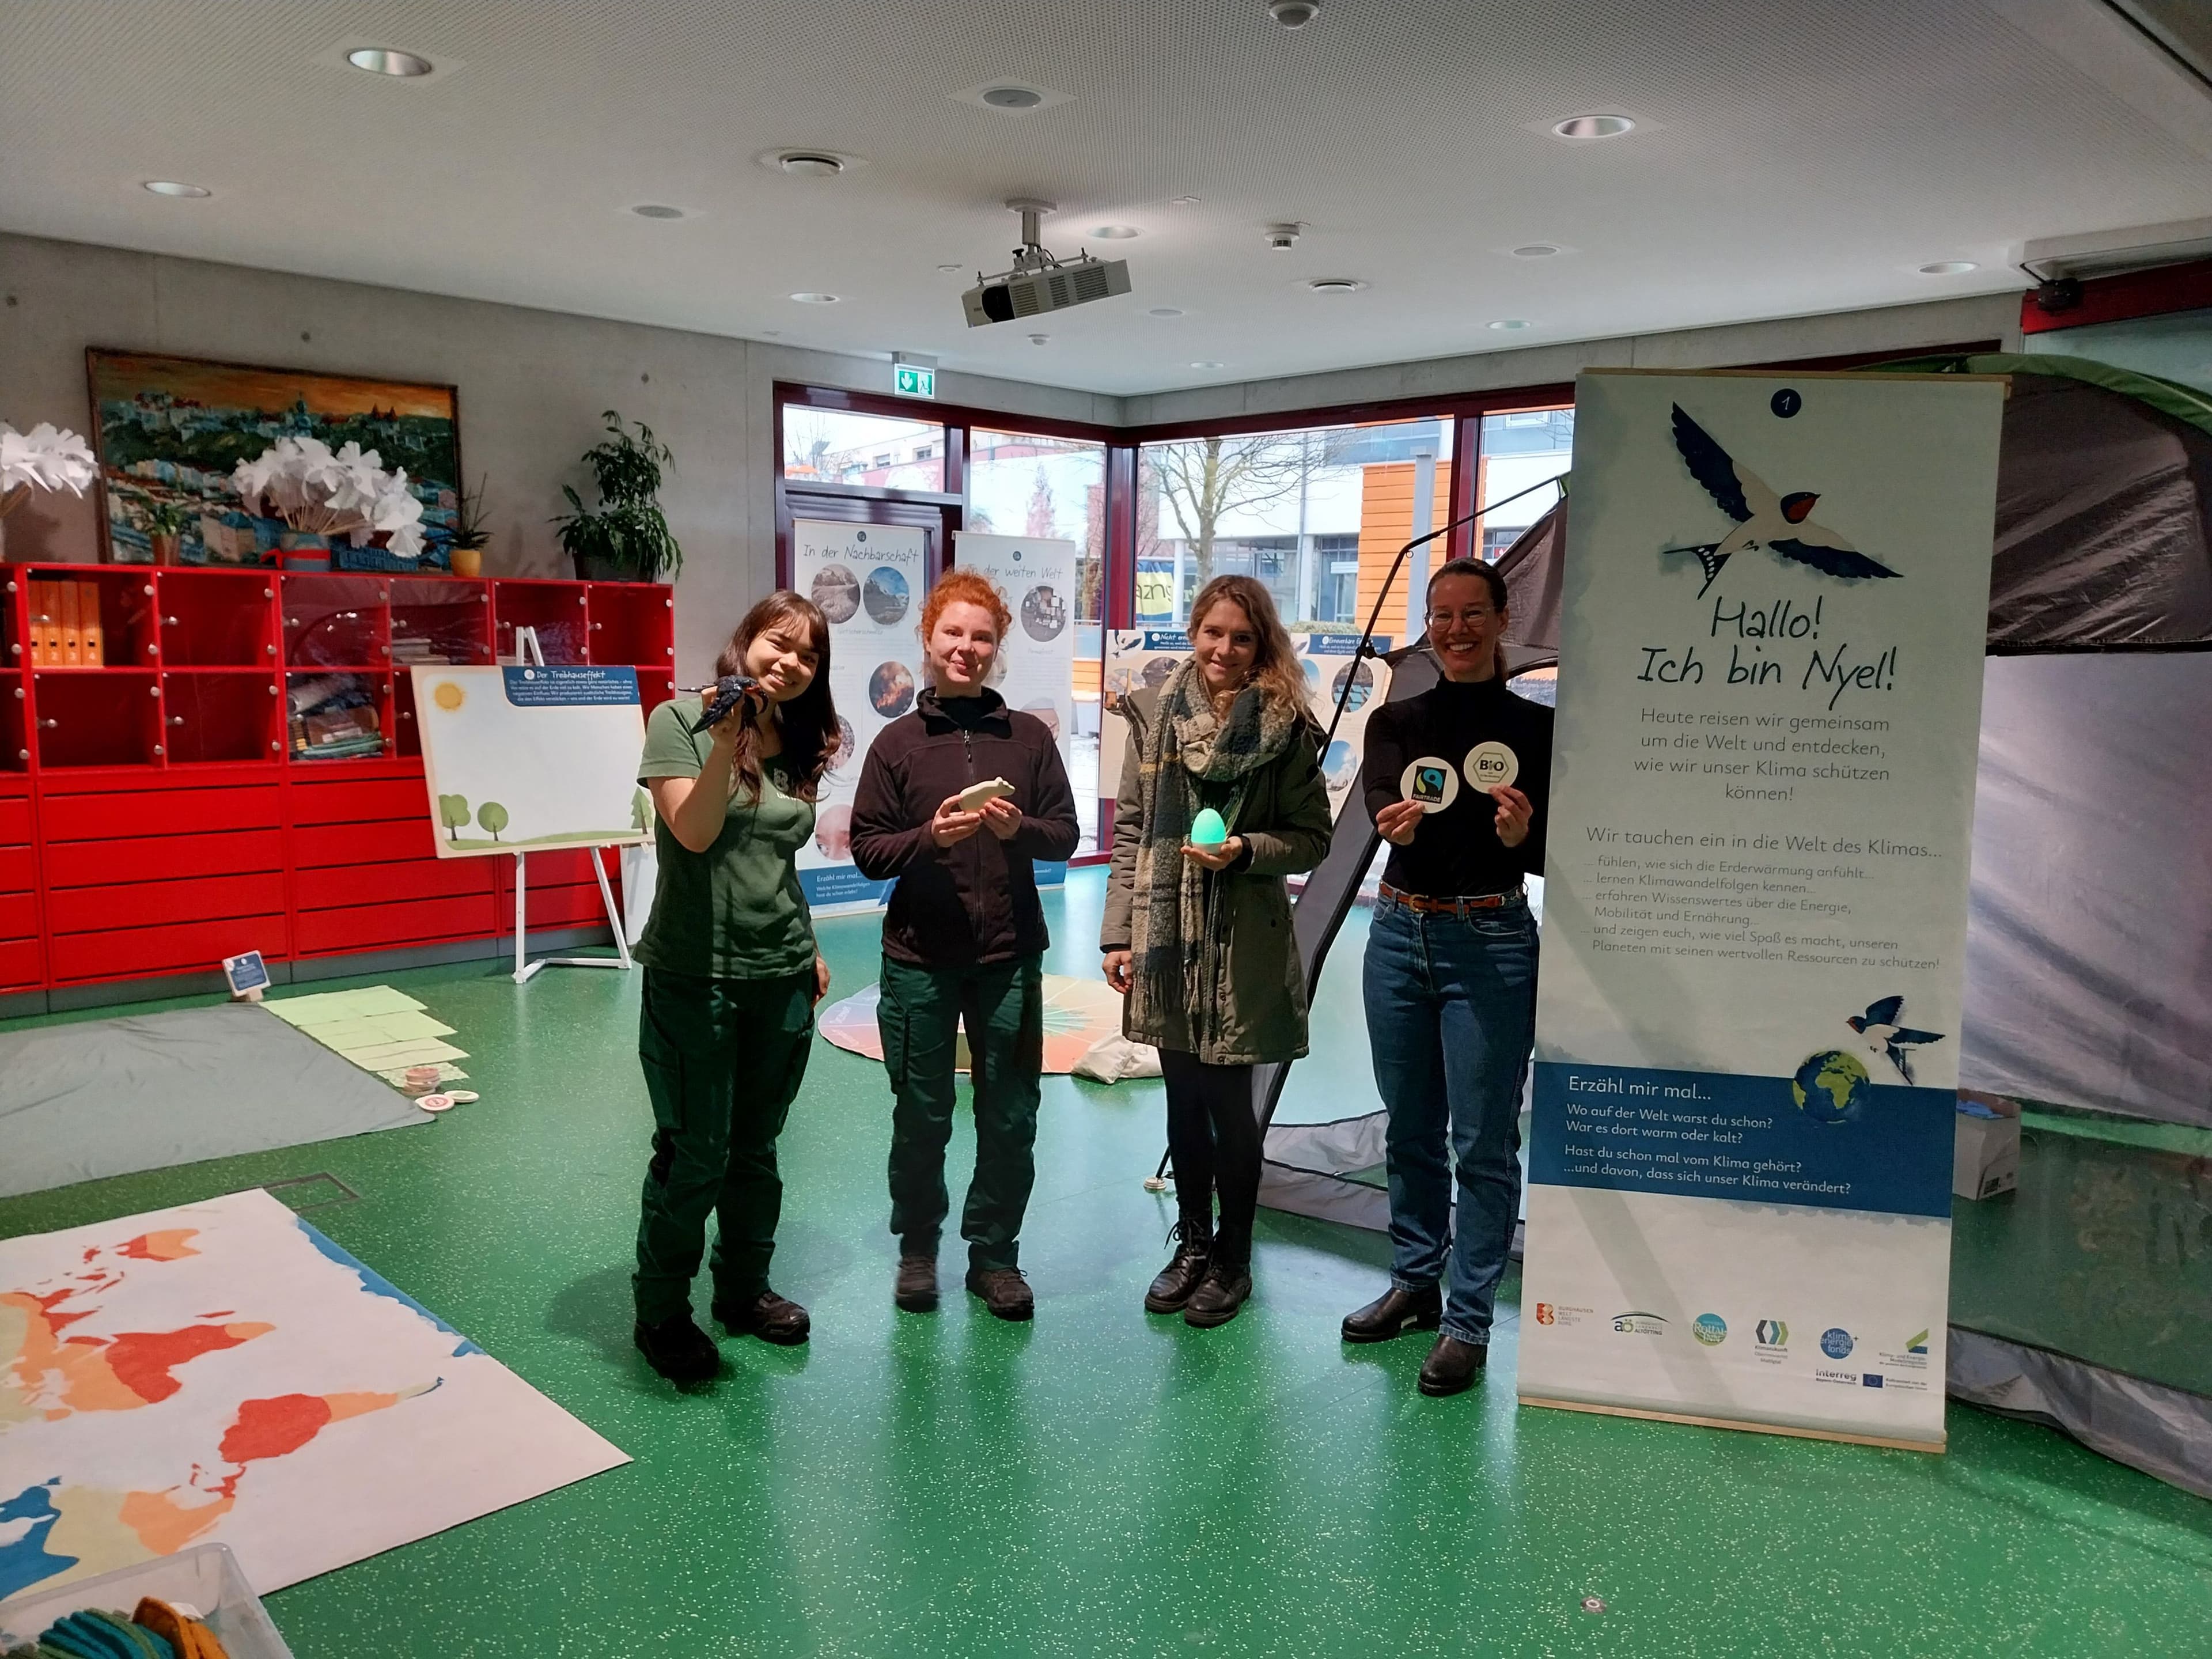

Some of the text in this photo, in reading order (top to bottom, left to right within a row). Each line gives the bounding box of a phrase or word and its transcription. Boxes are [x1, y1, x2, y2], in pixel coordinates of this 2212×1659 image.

[804, 544, 919, 566] In der Nachbarschaft
[984, 564, 999, 577] der
[1005, 564, 1036, 578] weiten
[1041, 567, 1063, 579] Welt
[1711, 596, 1822, 639] Hallo!
[551, 671, 605, 681] Treibhauseffekt
[1637, 643, 1896, 711] Ich bin Nyel!
[1642, 709, 1889, 733] Heute reisen wir gemeinsam
[1642, 733, 1884, 759] um die Welt und entdecken,
[1635, 758, 1889, 780] wie wir unser Klima schützen
[1726, 783, 1793, 801] können!
[1587, 827, 1941, 857] Wir tauchen ein in die Welt des Klimas...
[816, 873, 835, 882] Erzähl
[1599, 855, 1640, 869] fühlen,
[1645, 859, 1666, 869] wie
[1670, 859, 1692, 870] sich
[1696, 860, 1714, 871] die
[1720, 861, 1813, 880] Erderwärmung
[1597, 872, 1634, 884] lernen
[1639, 874, 1758, 893] Klimawandelfolgen
[1596, 889, 1647, 902] erfahren
[1652, 892, 1742, 907] Wissenswertes
[1747, 897, 1774, 908] über
[1778, 899, 1796, 910] die
[1595, 907, 1652, 919] Mobilität
[1657, 910, 1679, 921] und
[1594, 924, 1616, 934] und
[1620, 928, 1658, 940] zeigen
[1663, 927, 1694, 940] euch,
[1700, 929, 1721, 940] wie
[1725, 931, 1745, 941] viel
[1750, 931, 1781, 946] Spaß
[1801, 935, 1844, 949] macht,
[1850, 941, 1897, 949] unseren
[1593, 940, 1645, 953] Planeten
[1651, 944, 1671, 954] mit
[1675, 948, 1713, 956] seinen
[1718, 949, 1782, 960] wertvollen
[1788, 950, 1857, 964] Ressourcen
[1570, 1076, 1710, 1100] Erzähl mir mal...
[1567, 1104, 1772, 1128] Wo auf der Welt warst du schon?
[1566, 1120, 1592, 1131] War
[1612, 1123, 1638, 1135] dort
[1642, 1129, 1677, 1138] warm
[1681, 1129, 1709, 1141] oder
[1714, 1131, 1743, 1143] kalt?
[1566, 1145, 1801, 1173] Hast du schon mal vom Klima gehört?
[1601, 1164, 1642, 1179] davon,
[1647, 1167, 1673, 1179] dass
[1677, 1171, 1700, 1181] sich
[1705, 1176, 1738, 1184] unser
[1743, 1175, 1778, 1188] Klima
[1783, 1181, 1850, 1194] verändert?
